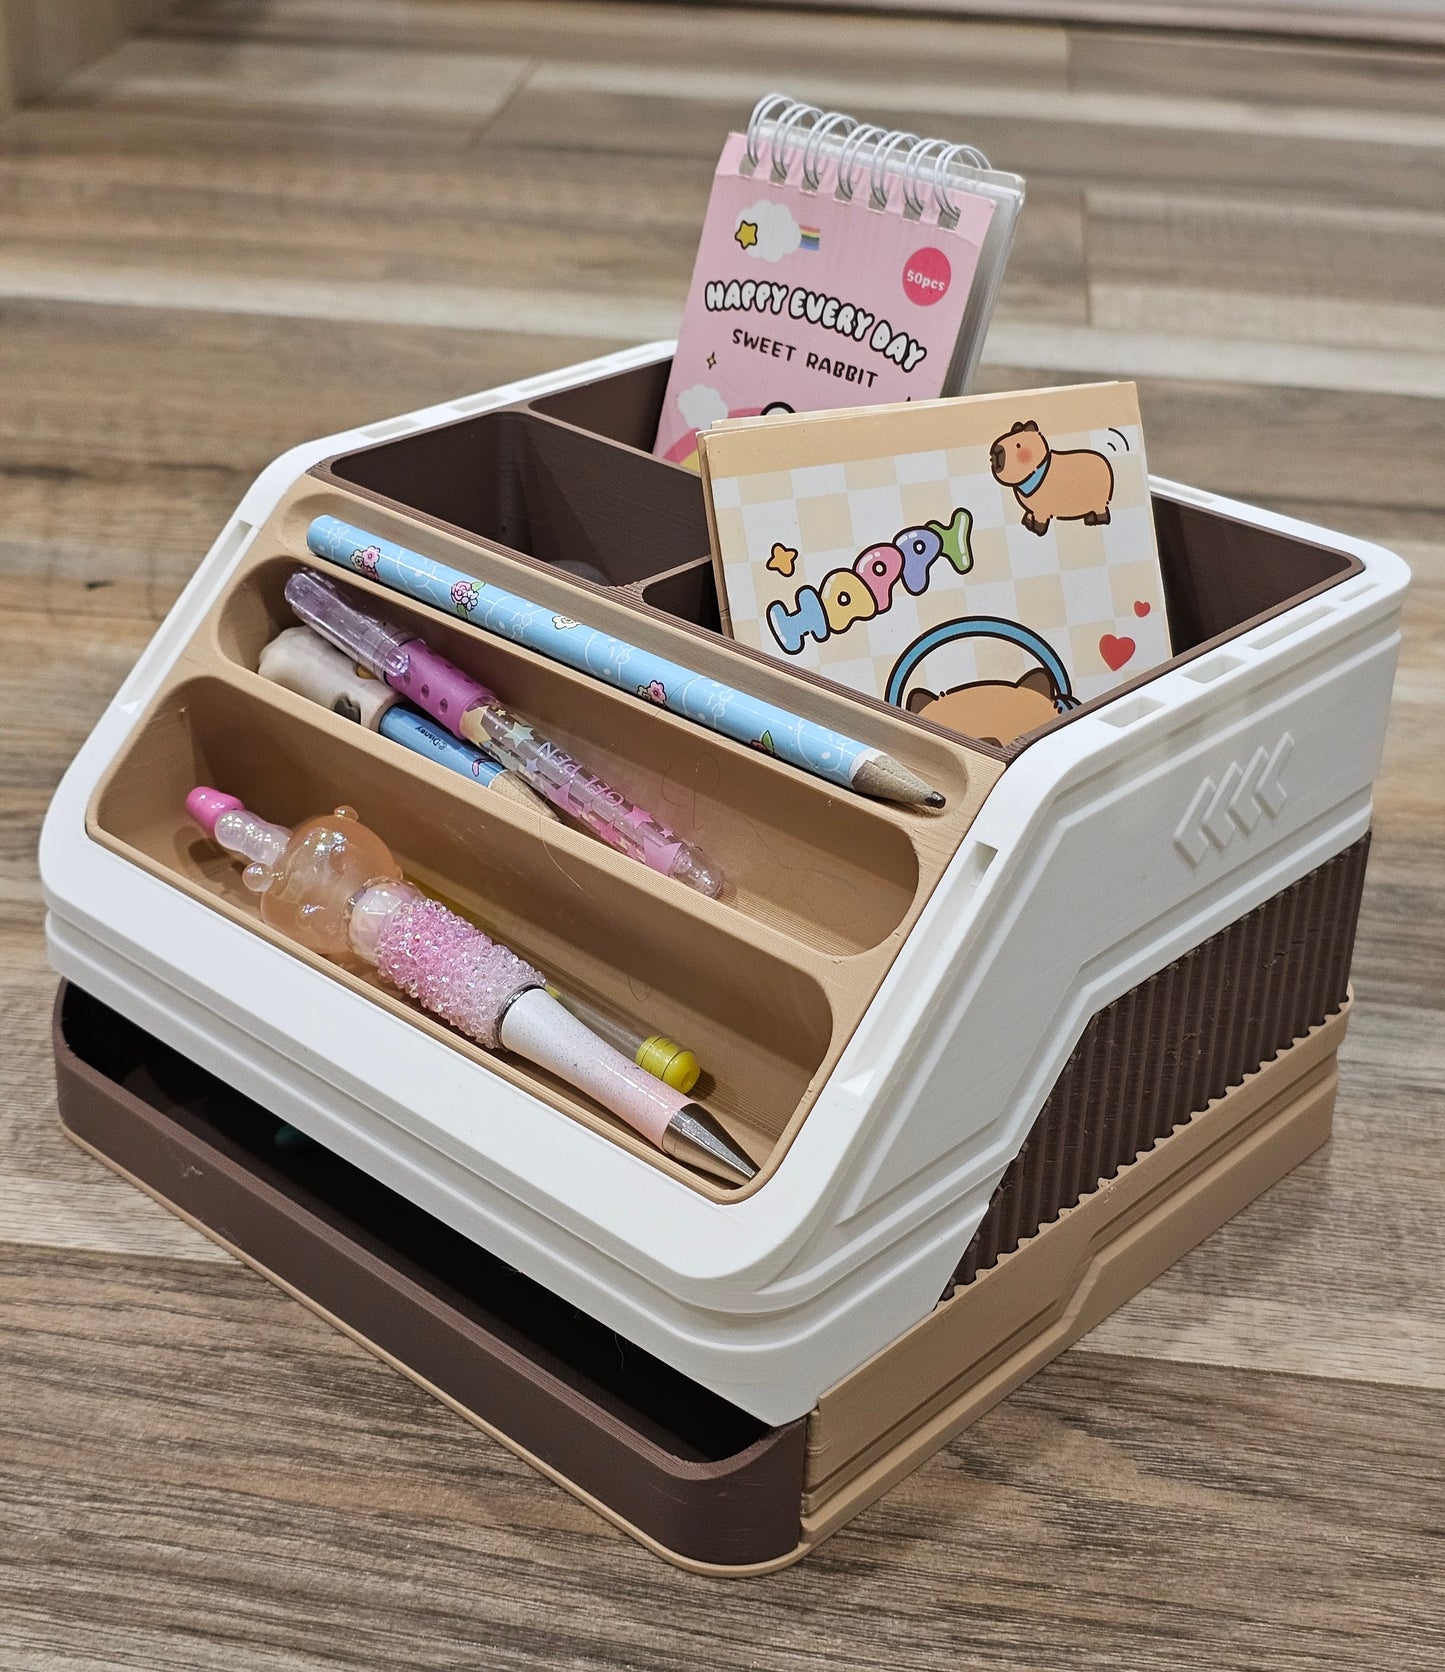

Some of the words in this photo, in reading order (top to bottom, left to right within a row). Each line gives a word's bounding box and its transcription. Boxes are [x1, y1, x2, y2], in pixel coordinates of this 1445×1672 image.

[906, 269, 945, 291] 50pcs
[705, 279, 788, 314] HAPPY
[788, 287, 875, 342] EVERY
[870, 319, 928, 373] DAY
[731, 328, 797, 362] SWEET
[806, 352, 879, 388] RABBIT
[766, 507, 974, 655] HAPPY
[537, 740, 581, 777] PEN
[584, 773, 625, 807] GEL
